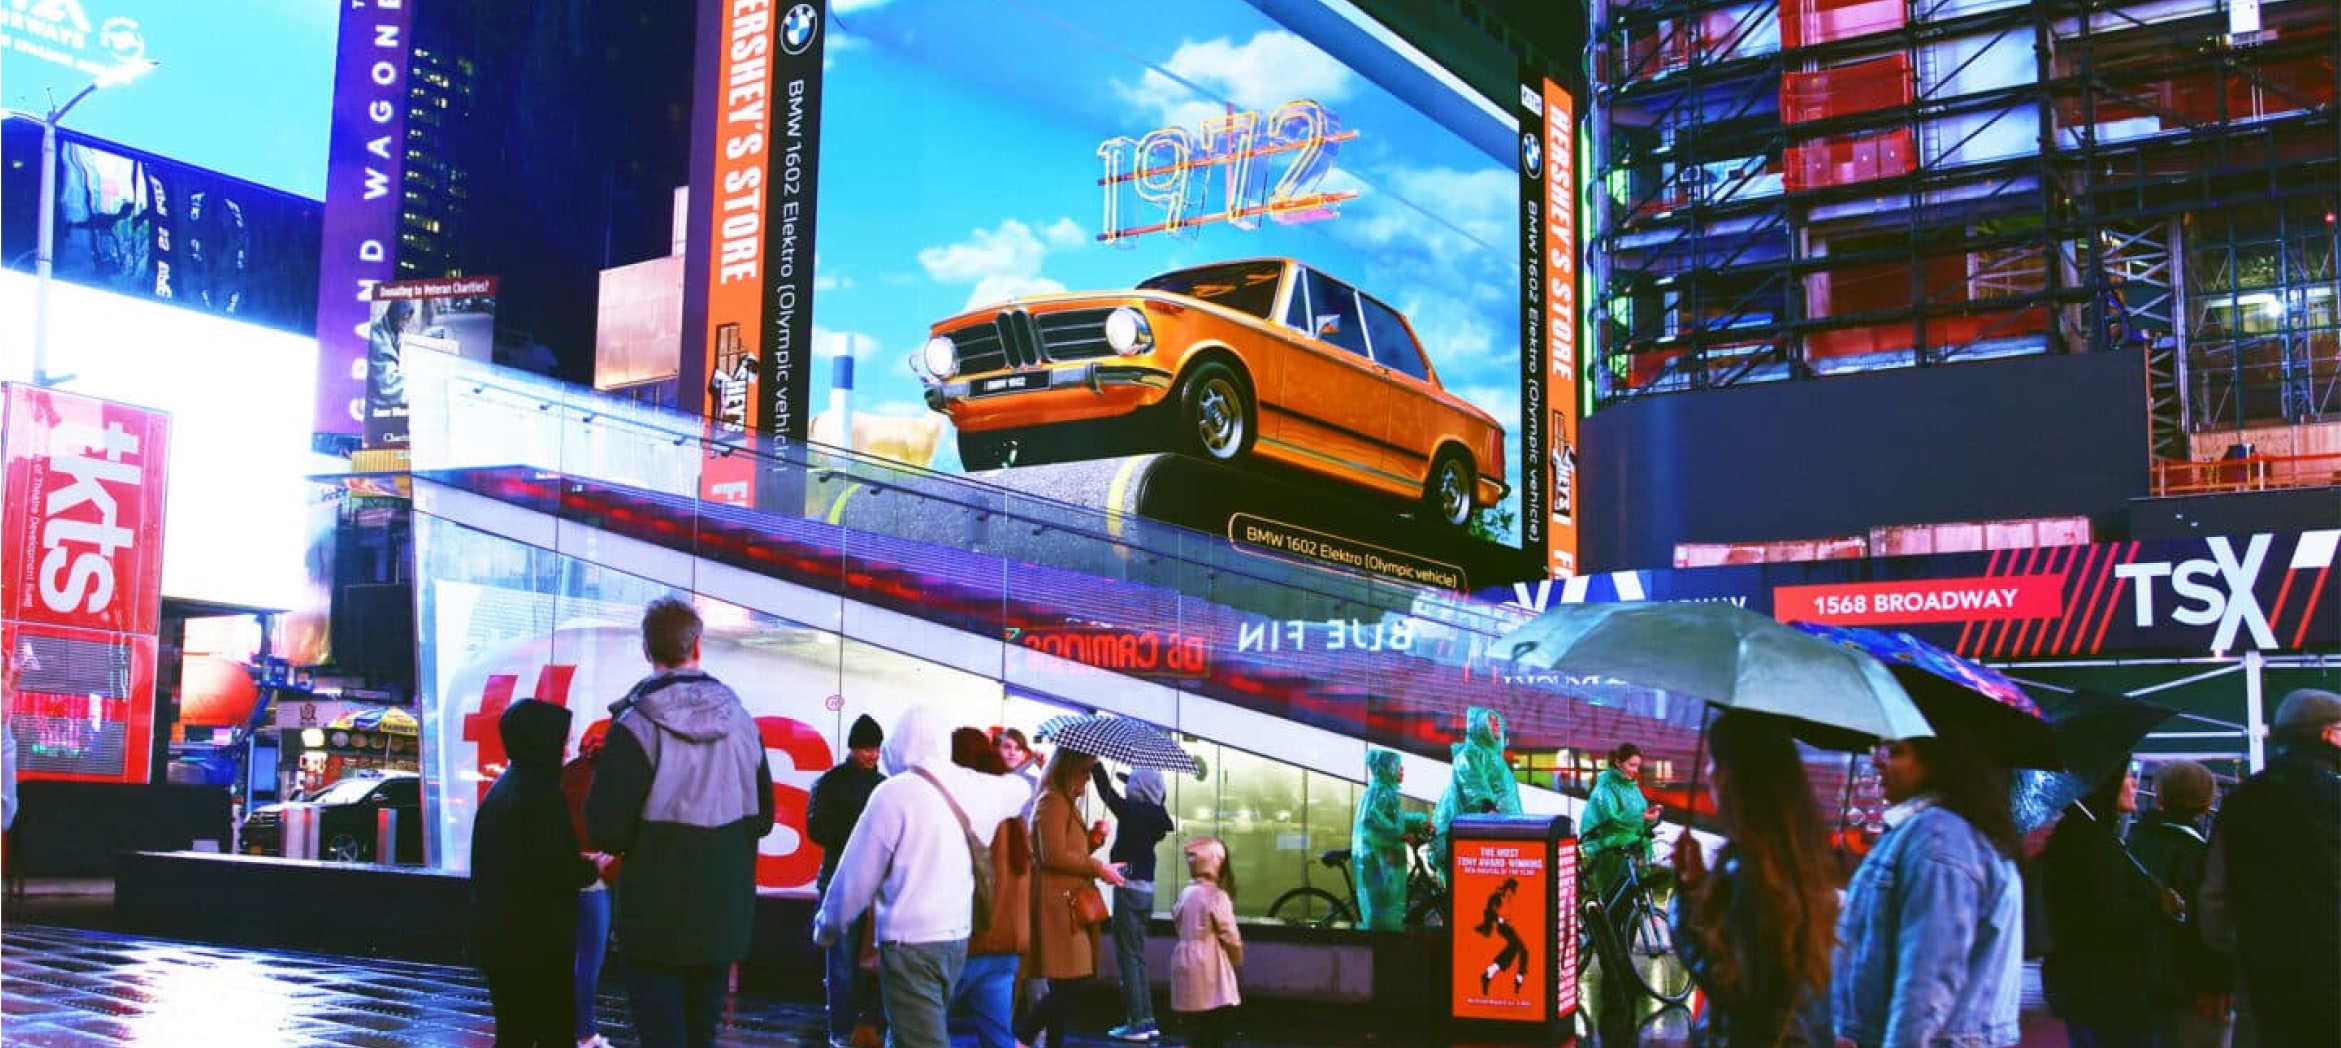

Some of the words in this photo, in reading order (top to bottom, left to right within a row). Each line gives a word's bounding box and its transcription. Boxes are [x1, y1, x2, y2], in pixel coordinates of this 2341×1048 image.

[786, 80, 804, 137] BMW
[784, 142, 801, 196] 1602
[1097, 98, 1340, 247] 1972
[1550, 104, 1571, 273] HERSHEY'S
[720, 166, 761, 284] STORE
[780, 202, 799, 277] Elektro
[1528, 201, 1538, 252] BMW
[1528, 256, 1539, 303] 1602
[776, 284, 795, 382] (Olympic
[1528, 309, 1539, 374] Elektro
[1552, 277, 1573, 381] STORE
[1528, 378, 1540, 463] (Olympic
[40, 419, 143, 613] tkts
[1528, 468, 1540, 543] vehicle)
[1246, 526, 1285, 549] BMW
[1286, 535, 1318, 556] 1602
[1319, 544, 1363, 567] Elektro
[1365, 553, 1417, 579] (Olympic
[1415, 567, 1459, 589] vehicle)
[2115, 533, 2278, 651] TSX
[1813, 594, 1867, 616] 1568
[1873, 588, 2019, 614] BROADWAY
